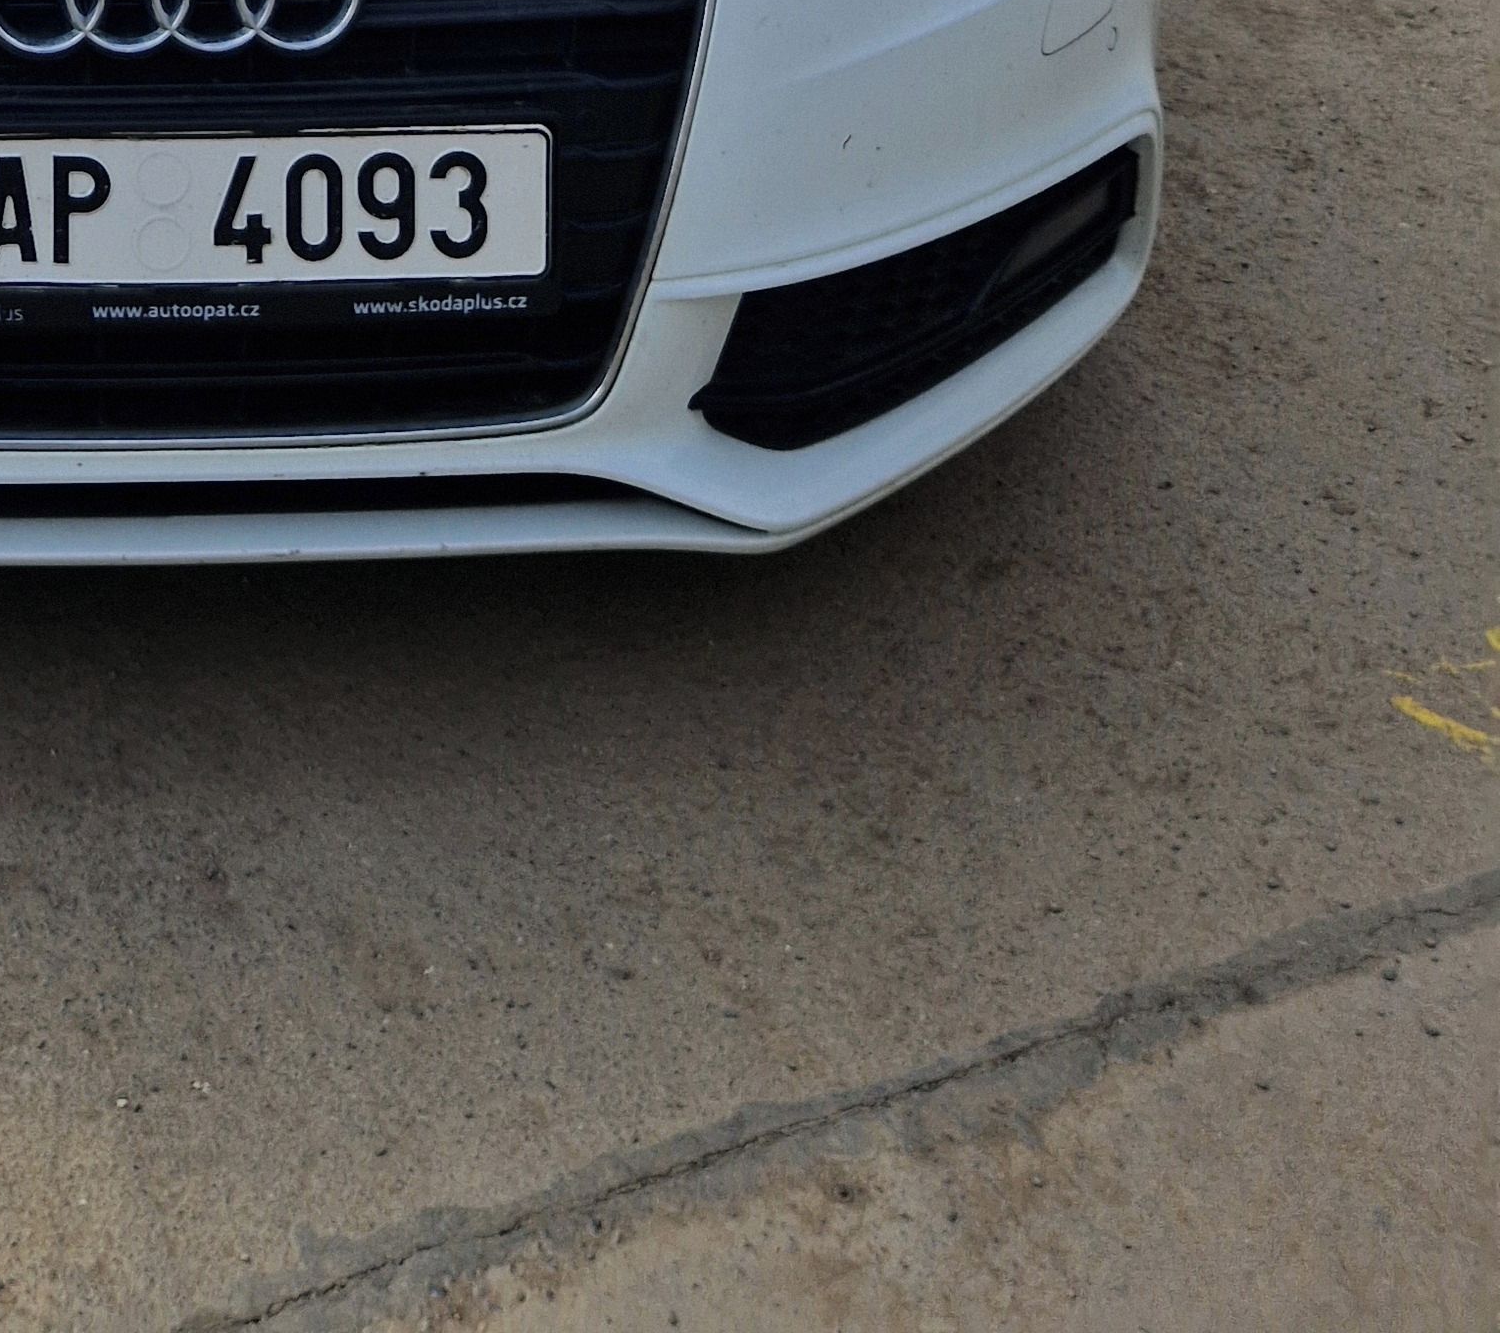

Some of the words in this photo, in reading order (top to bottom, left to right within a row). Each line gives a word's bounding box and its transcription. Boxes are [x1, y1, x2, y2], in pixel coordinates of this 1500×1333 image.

[213, 150, 488, 265] 4093
[92, 304, 261, 320] www.autoopat.cz
[353, 293, 528, 314] www.skodaplus.cz
